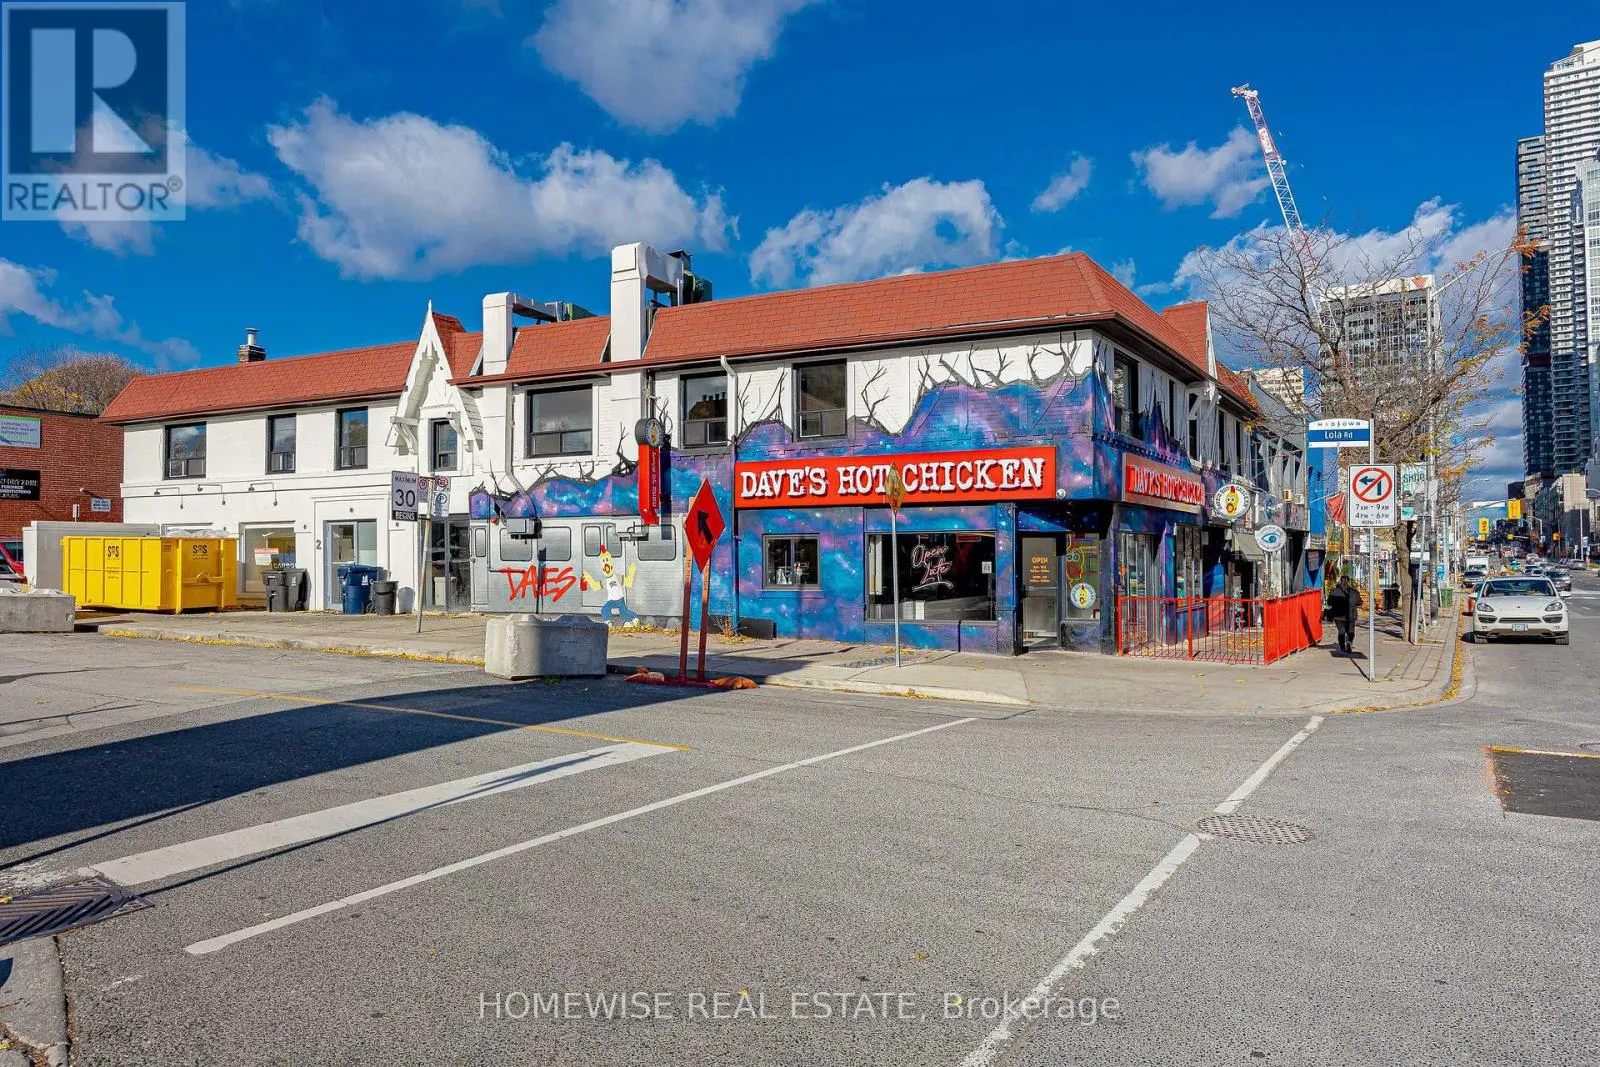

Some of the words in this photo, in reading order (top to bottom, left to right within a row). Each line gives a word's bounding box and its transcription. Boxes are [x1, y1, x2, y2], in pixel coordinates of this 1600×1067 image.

[1325, 431, 1342, 439] Lola
[1344, 431, 1353, 439] Rd
[740, 471, 828, 498] DAVE'S
[837, 464, 891, 494] HOT
[901, 457, 1045, 493] CHICKEN
[395, 489, 416, 507] 30
[395, 511, 415, 520] BEGINS
[315, 539, 322, 550] 2
[912, 544, 949, 569] Open
[1031, 556, 1049, 564] OPEN
[920, 557, 953, 585] Late
[500, 564, 577, 602] DAES
